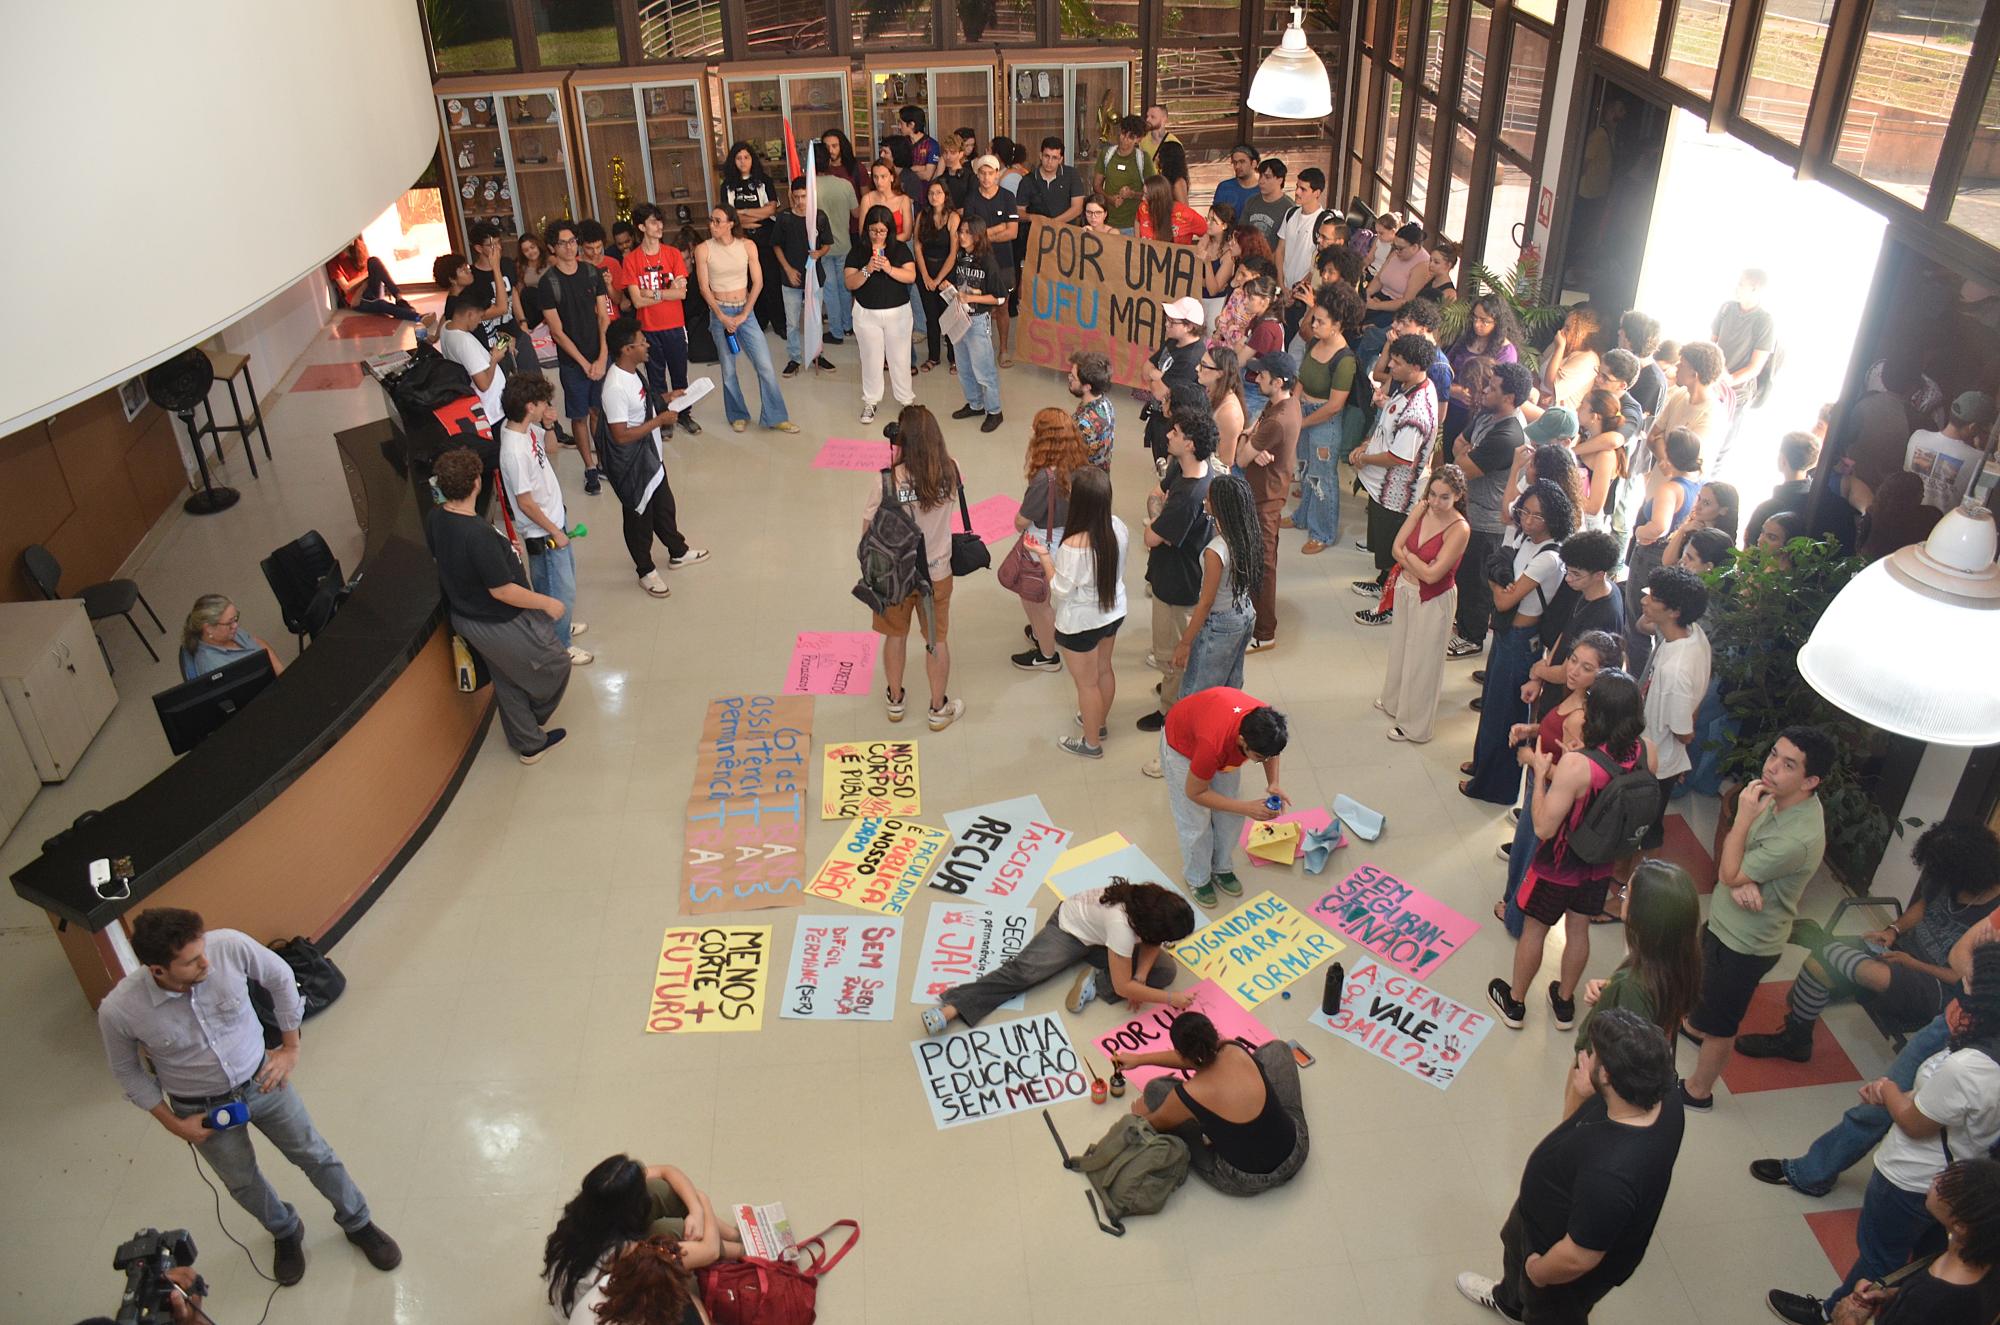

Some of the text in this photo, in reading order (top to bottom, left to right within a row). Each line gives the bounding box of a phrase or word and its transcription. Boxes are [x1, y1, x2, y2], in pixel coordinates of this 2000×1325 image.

[1036, 225, 1195, 298] POR UMA
[1032, 275, 1098, 330] UFU
[841, 753, 865, 763] É
[866, 743, 888, 797] CORPO
[891, 743, 916, 799] NOSSO
[688, 799, 725, 903] TRANS
[762, 792, 801, 895] TRANS
[848, 817, 882, 853] CORPO
[857, 820, 902, 875] O NOSSO
[929, 815, 1011, 894] RECUA
[986, 821, 1065, 896] FASCISTA
[814, 860, 856, 899] NÃO
[881, 840, 938, 913] FACULDADE
[1354, 865, 1413, 904] SEM
[693, 929, 727, 990] CORTE
[931, 933, 978, 975] JÁ!
[1176, 896, 1288, 966] DIGNIDADE
[1229, 927, 1287, 966] PARA
[650, 931, 700, 1032] FUTURO
[719, 932, 764, 1020] MENOS
[852, 927, 896, 1015] SEM SEGU
[1237, 934, 1334, 1003] FORMAR
[1351, 964, 1485, 1036] A GENTE
[1369, 996, 1439, 1043] VALE
[919, 1017, 1069, 1075] POR UMA
[1101, 1021, 1161, 1056] POR
[930, 1047, 1077, 1099] EDUCAÇÃO
[941, 1072, 1087, 1122] SEM MEDO
